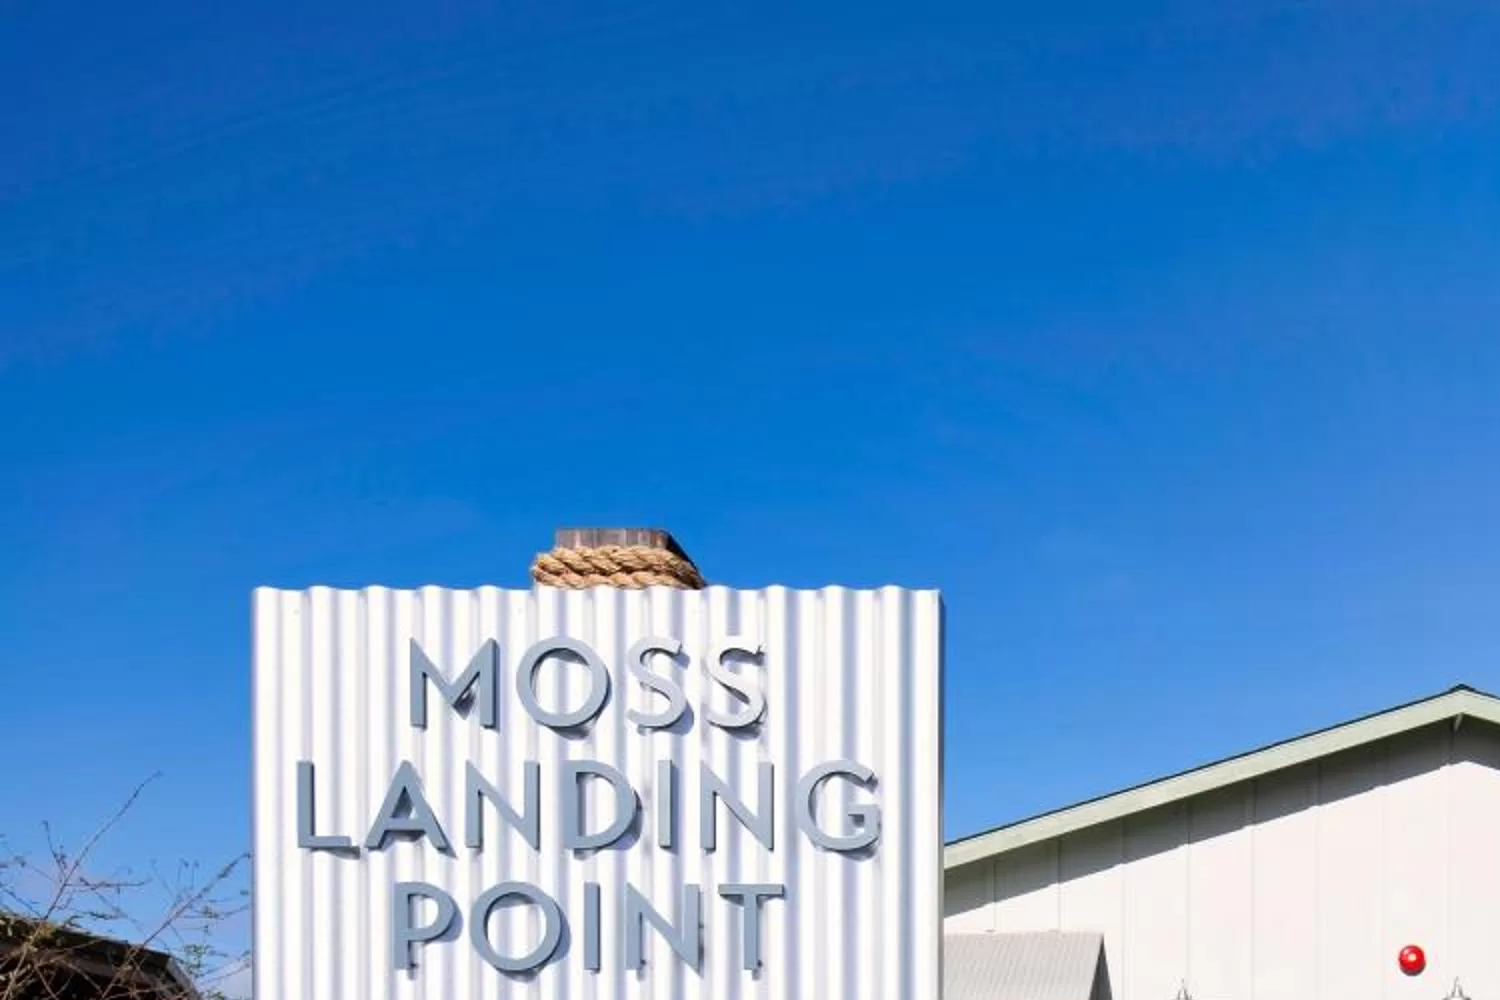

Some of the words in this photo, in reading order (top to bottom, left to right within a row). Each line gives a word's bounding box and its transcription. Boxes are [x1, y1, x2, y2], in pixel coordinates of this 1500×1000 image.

[409, 636, 766, 731] MOSS
[297, 760, 880, 852] LANDING
[394, 881, 784, 972] POINT
